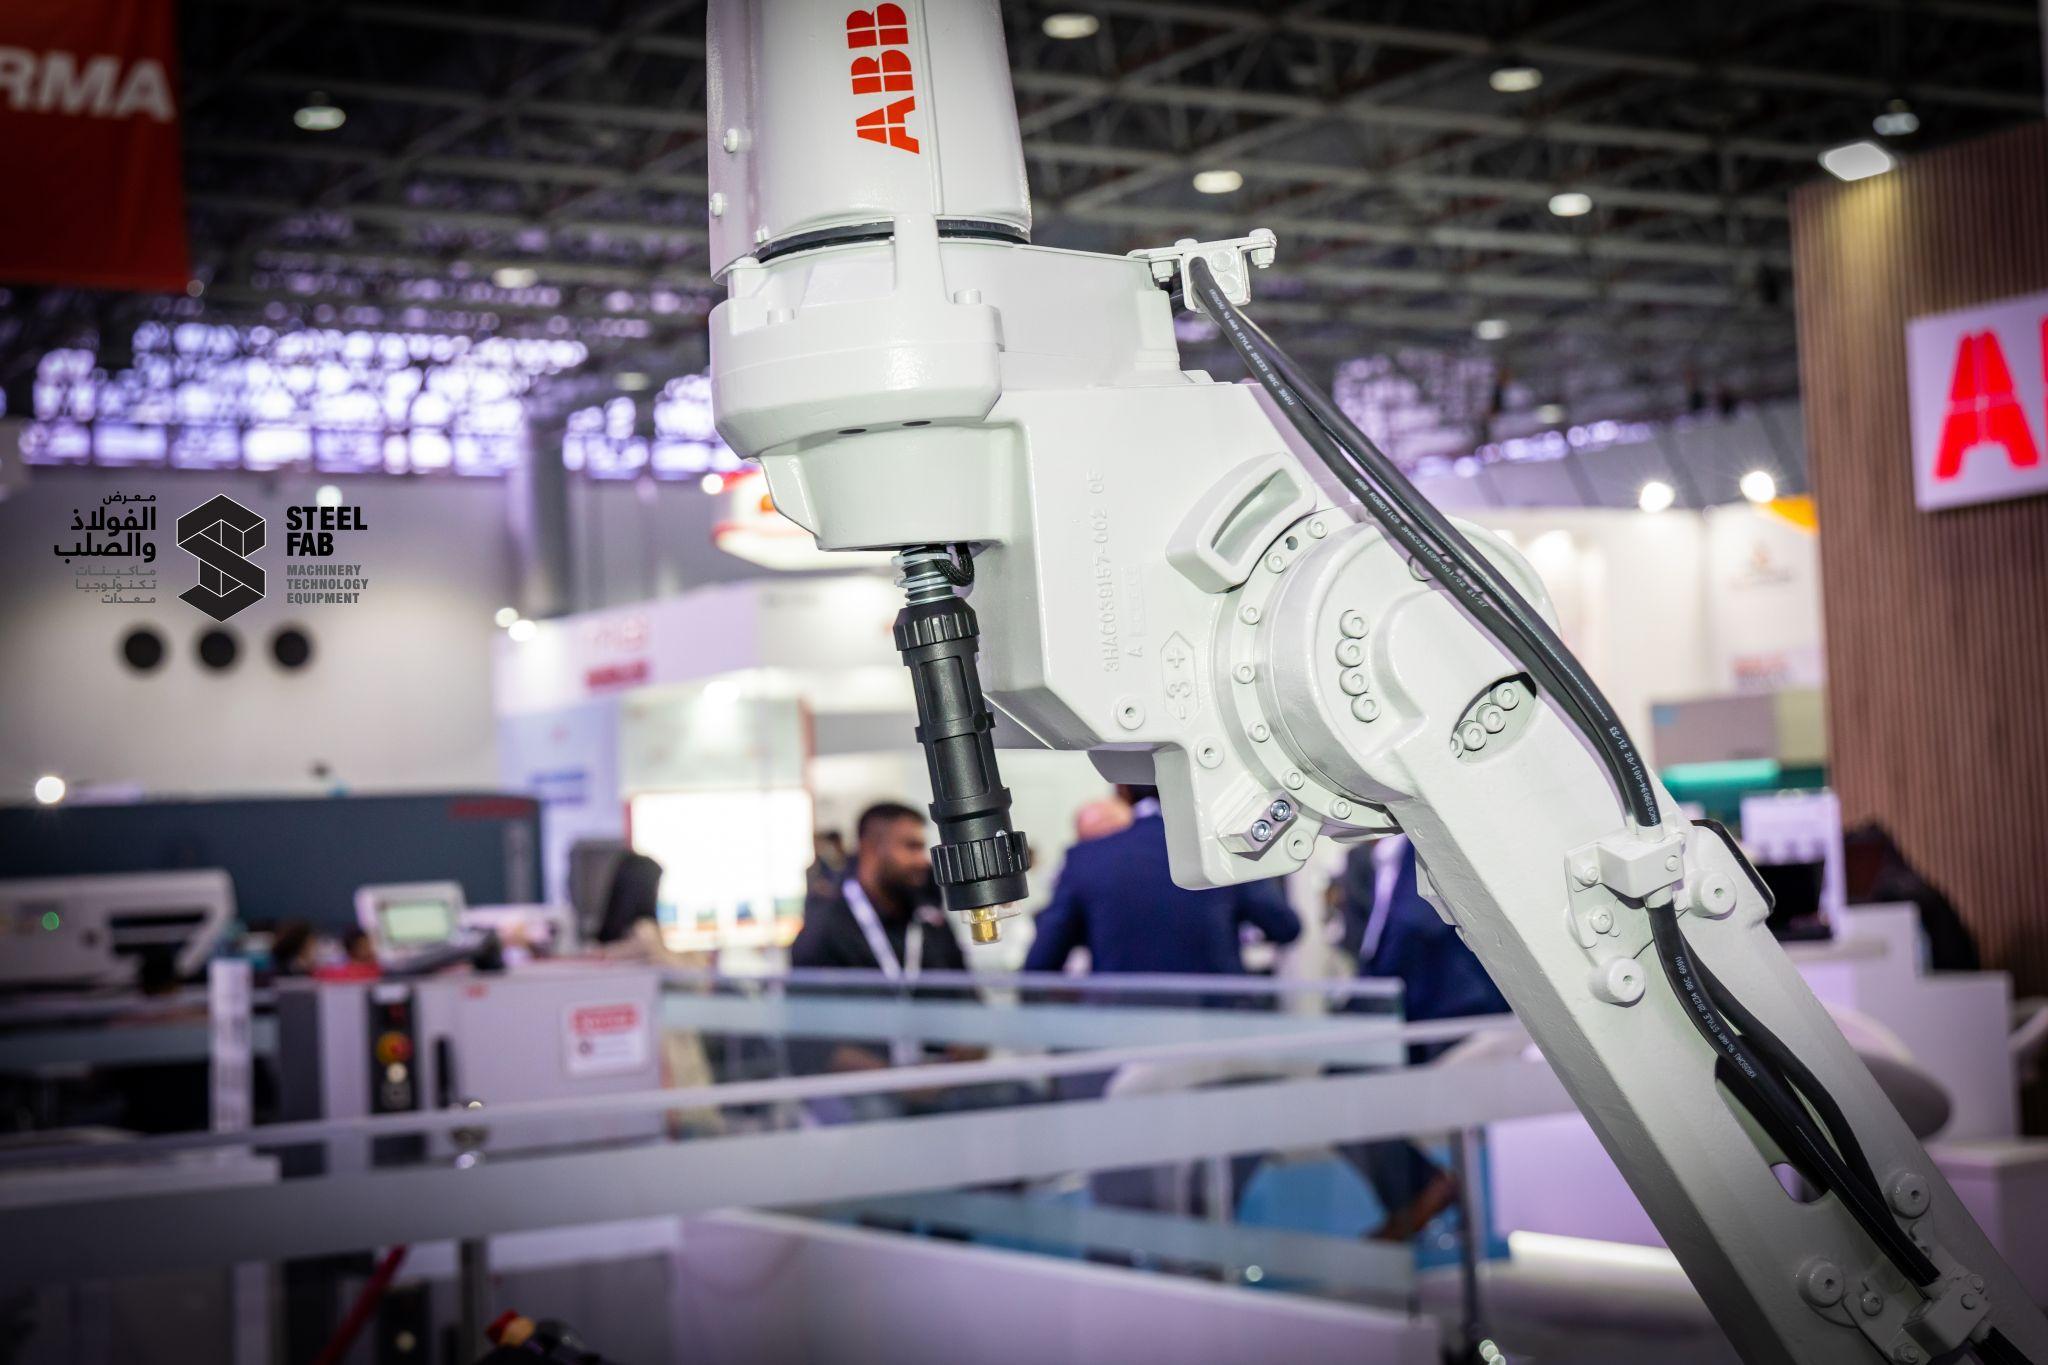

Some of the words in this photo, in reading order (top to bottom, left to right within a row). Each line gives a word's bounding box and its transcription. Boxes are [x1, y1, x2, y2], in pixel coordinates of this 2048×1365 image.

[846, 3, 920, 155] ABB
[1934, 316, 2048, 480] A
[1369, 492, 1400, 524] ROBOTICS
[1703, 1012, 1720, 1033] STYLE
